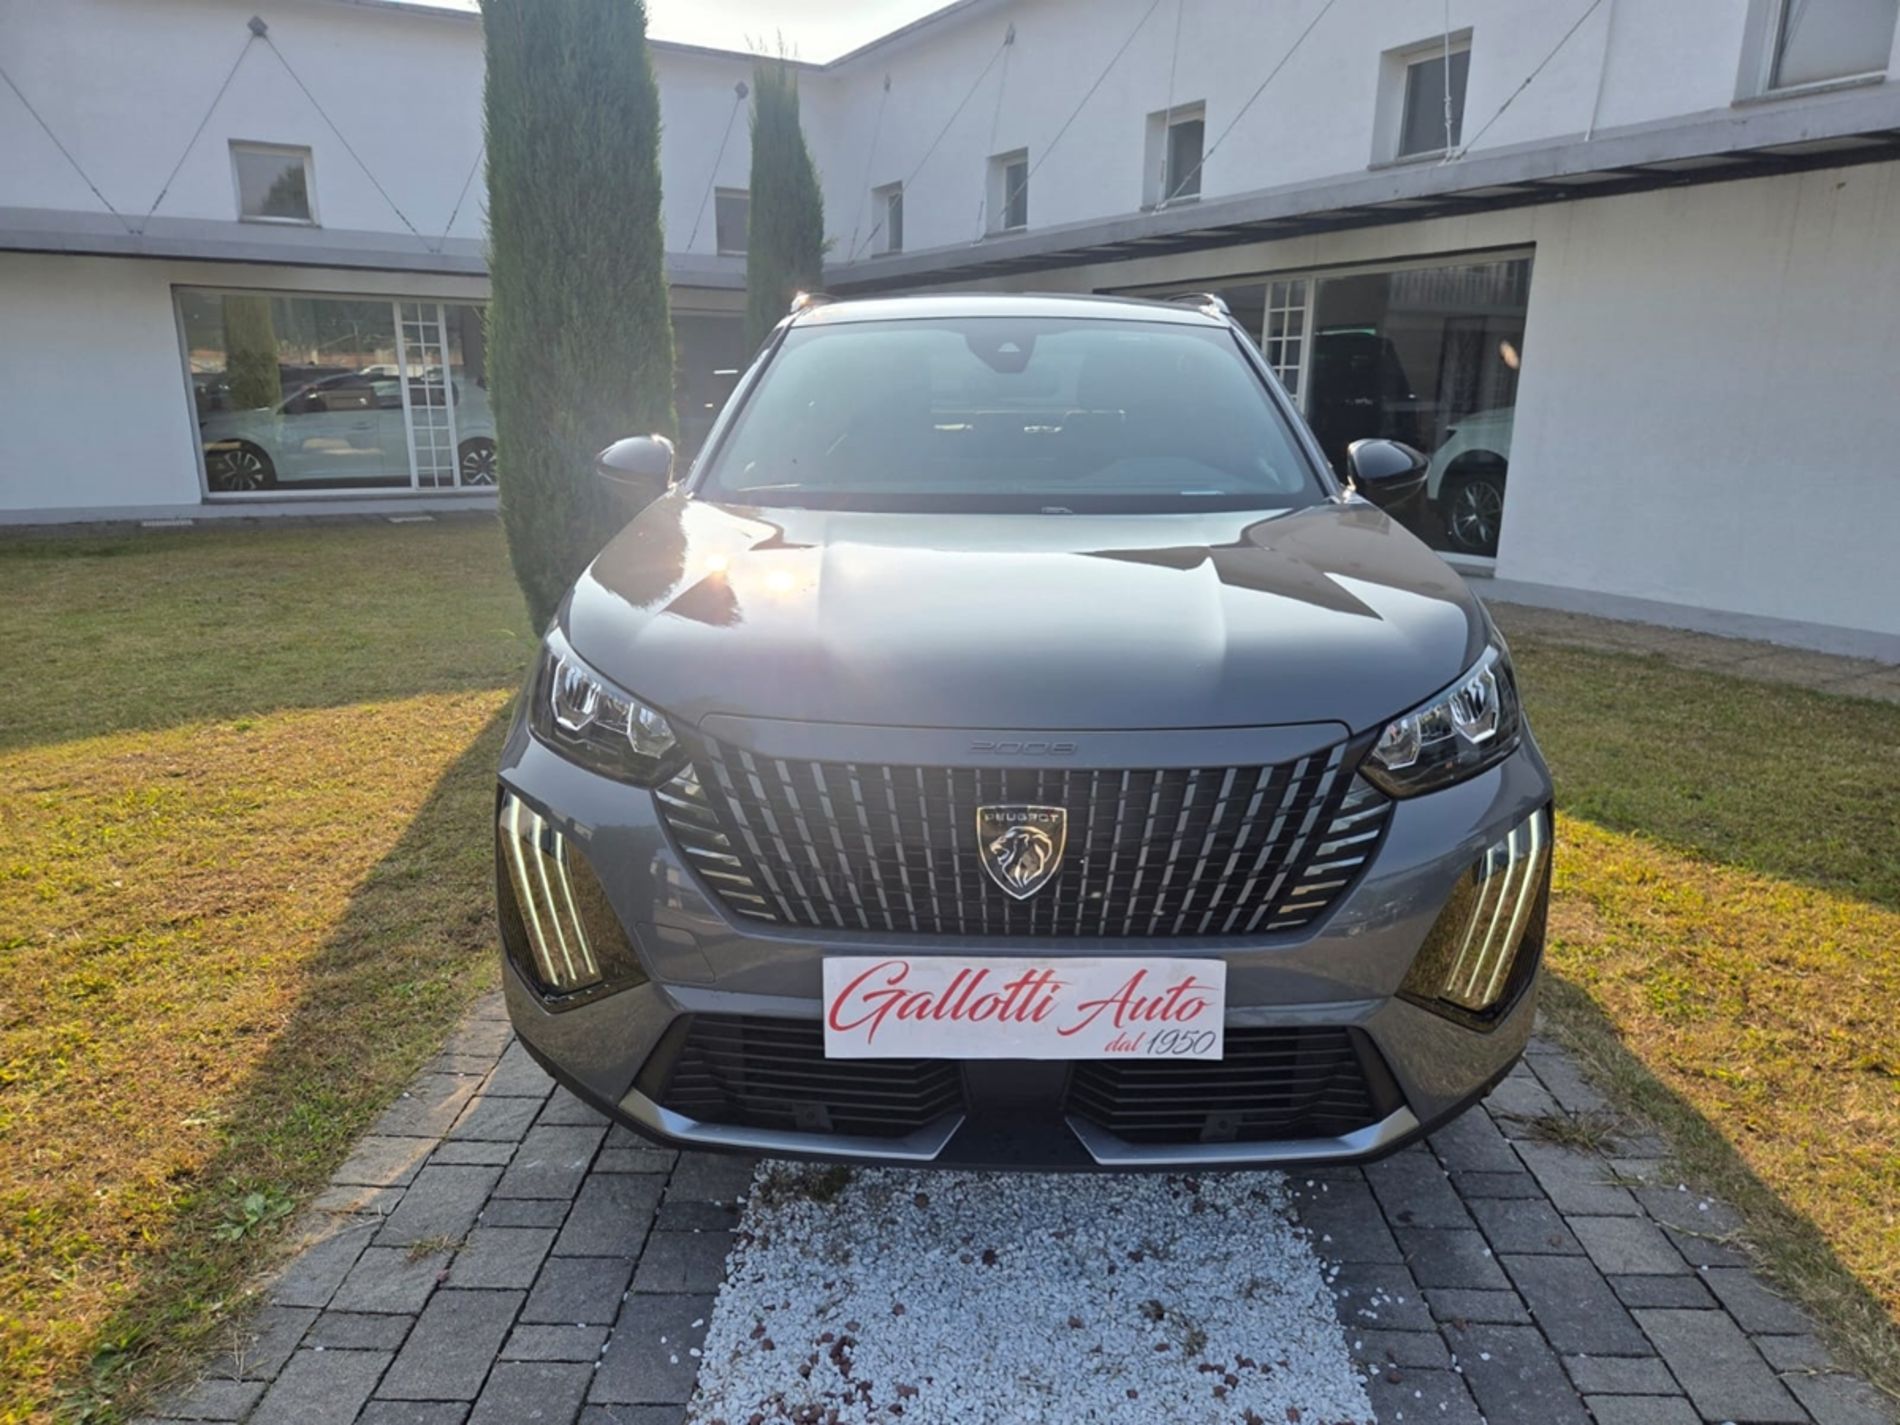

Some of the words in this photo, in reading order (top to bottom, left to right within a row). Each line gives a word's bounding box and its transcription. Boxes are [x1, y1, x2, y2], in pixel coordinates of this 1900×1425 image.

[970, 741, 1078, 756] 2008
[828, 960, 1073, 1045] Gallotti
[1057, 968, 1219, 1036] Auto
[1104, 1032, 1142, 1053] dal
[1146, 1029, 1217, 1056] 1950
